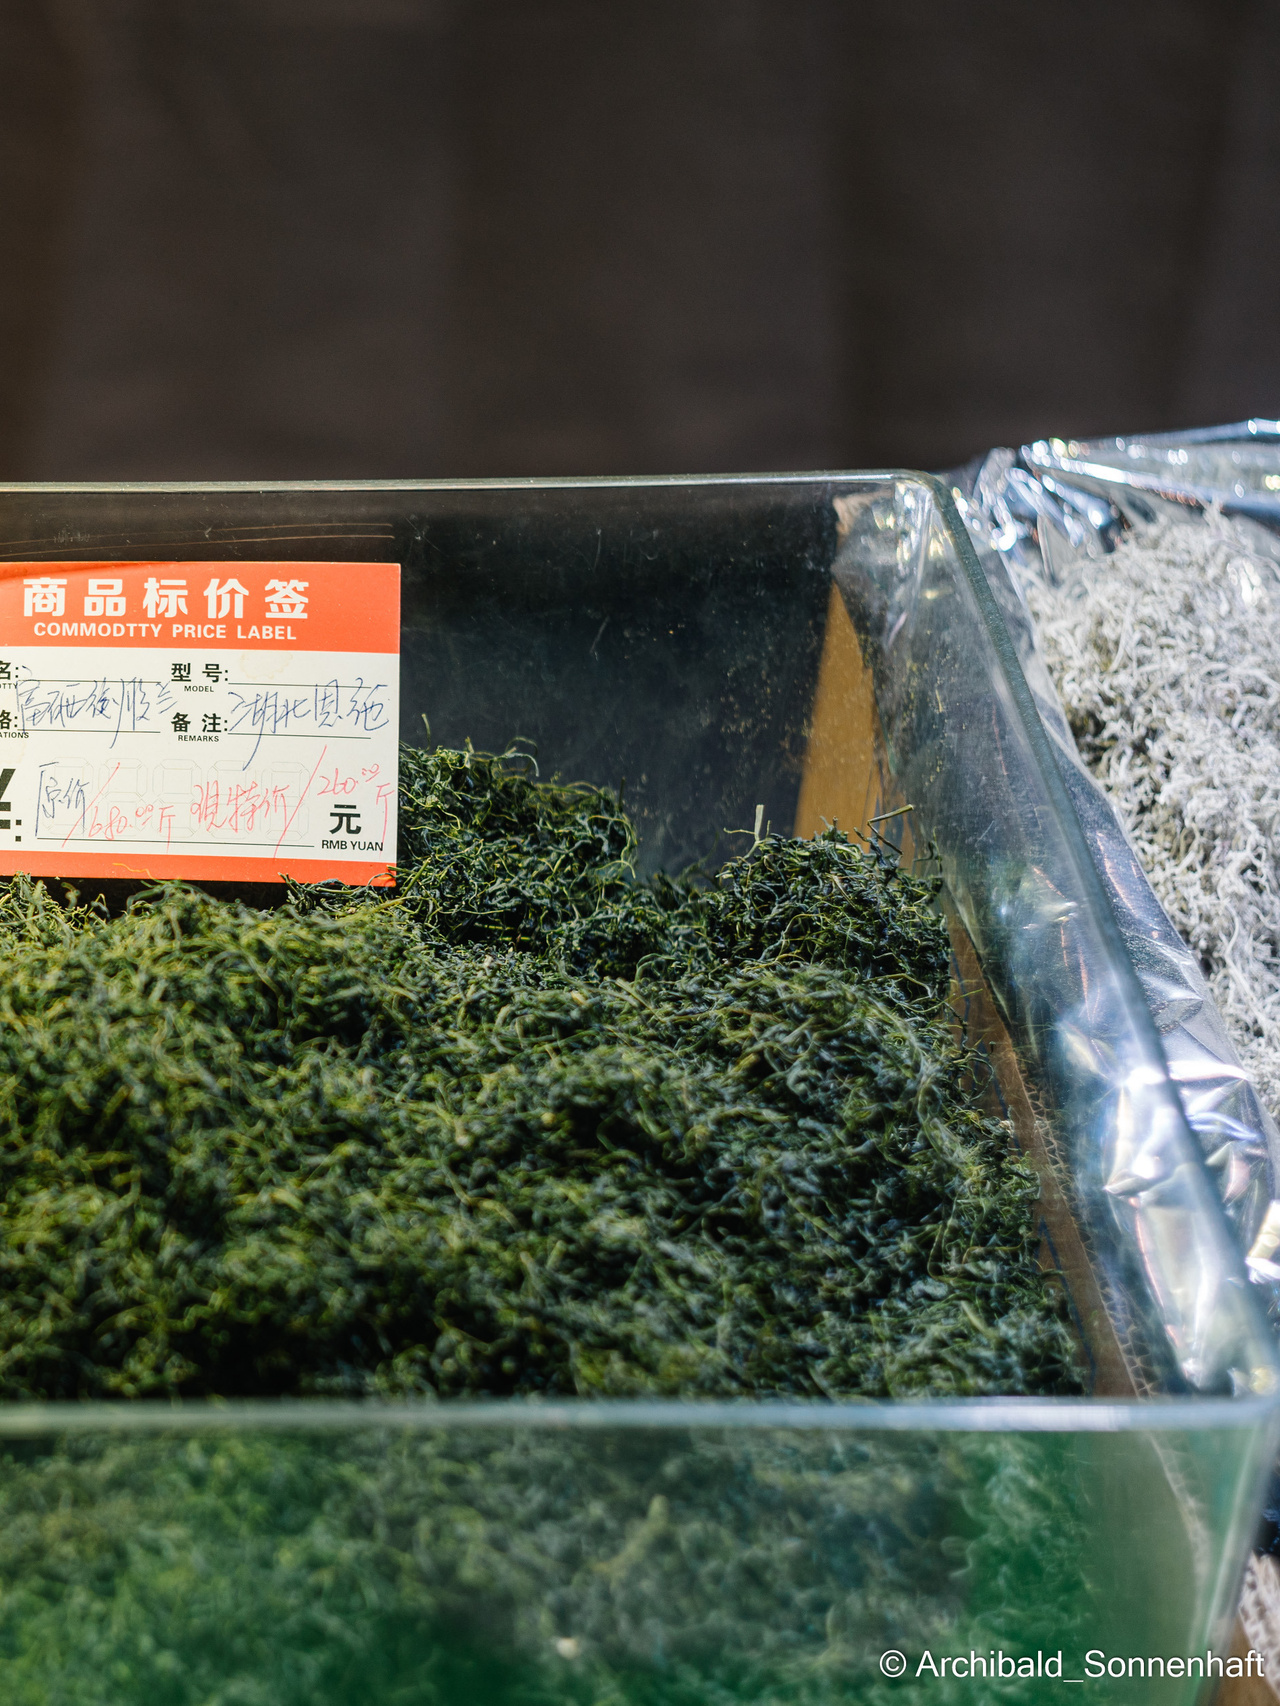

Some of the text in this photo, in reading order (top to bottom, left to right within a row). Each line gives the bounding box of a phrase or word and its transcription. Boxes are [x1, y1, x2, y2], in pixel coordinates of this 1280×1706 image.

[23, 578, 310, 620] 商品标价签
[34, 622, 297, 641] COMMODTTY PRICE LABEL
[171, 663, 229, 683] 型号:
[184, 685, 214, 693] MODEL
[171, 712, 228, 733] 备注:
[177, 734, 220, 743] REMARKS
[329, 803, 362, 835] 元
[321, 840, 384, 852] RMB YUAN
